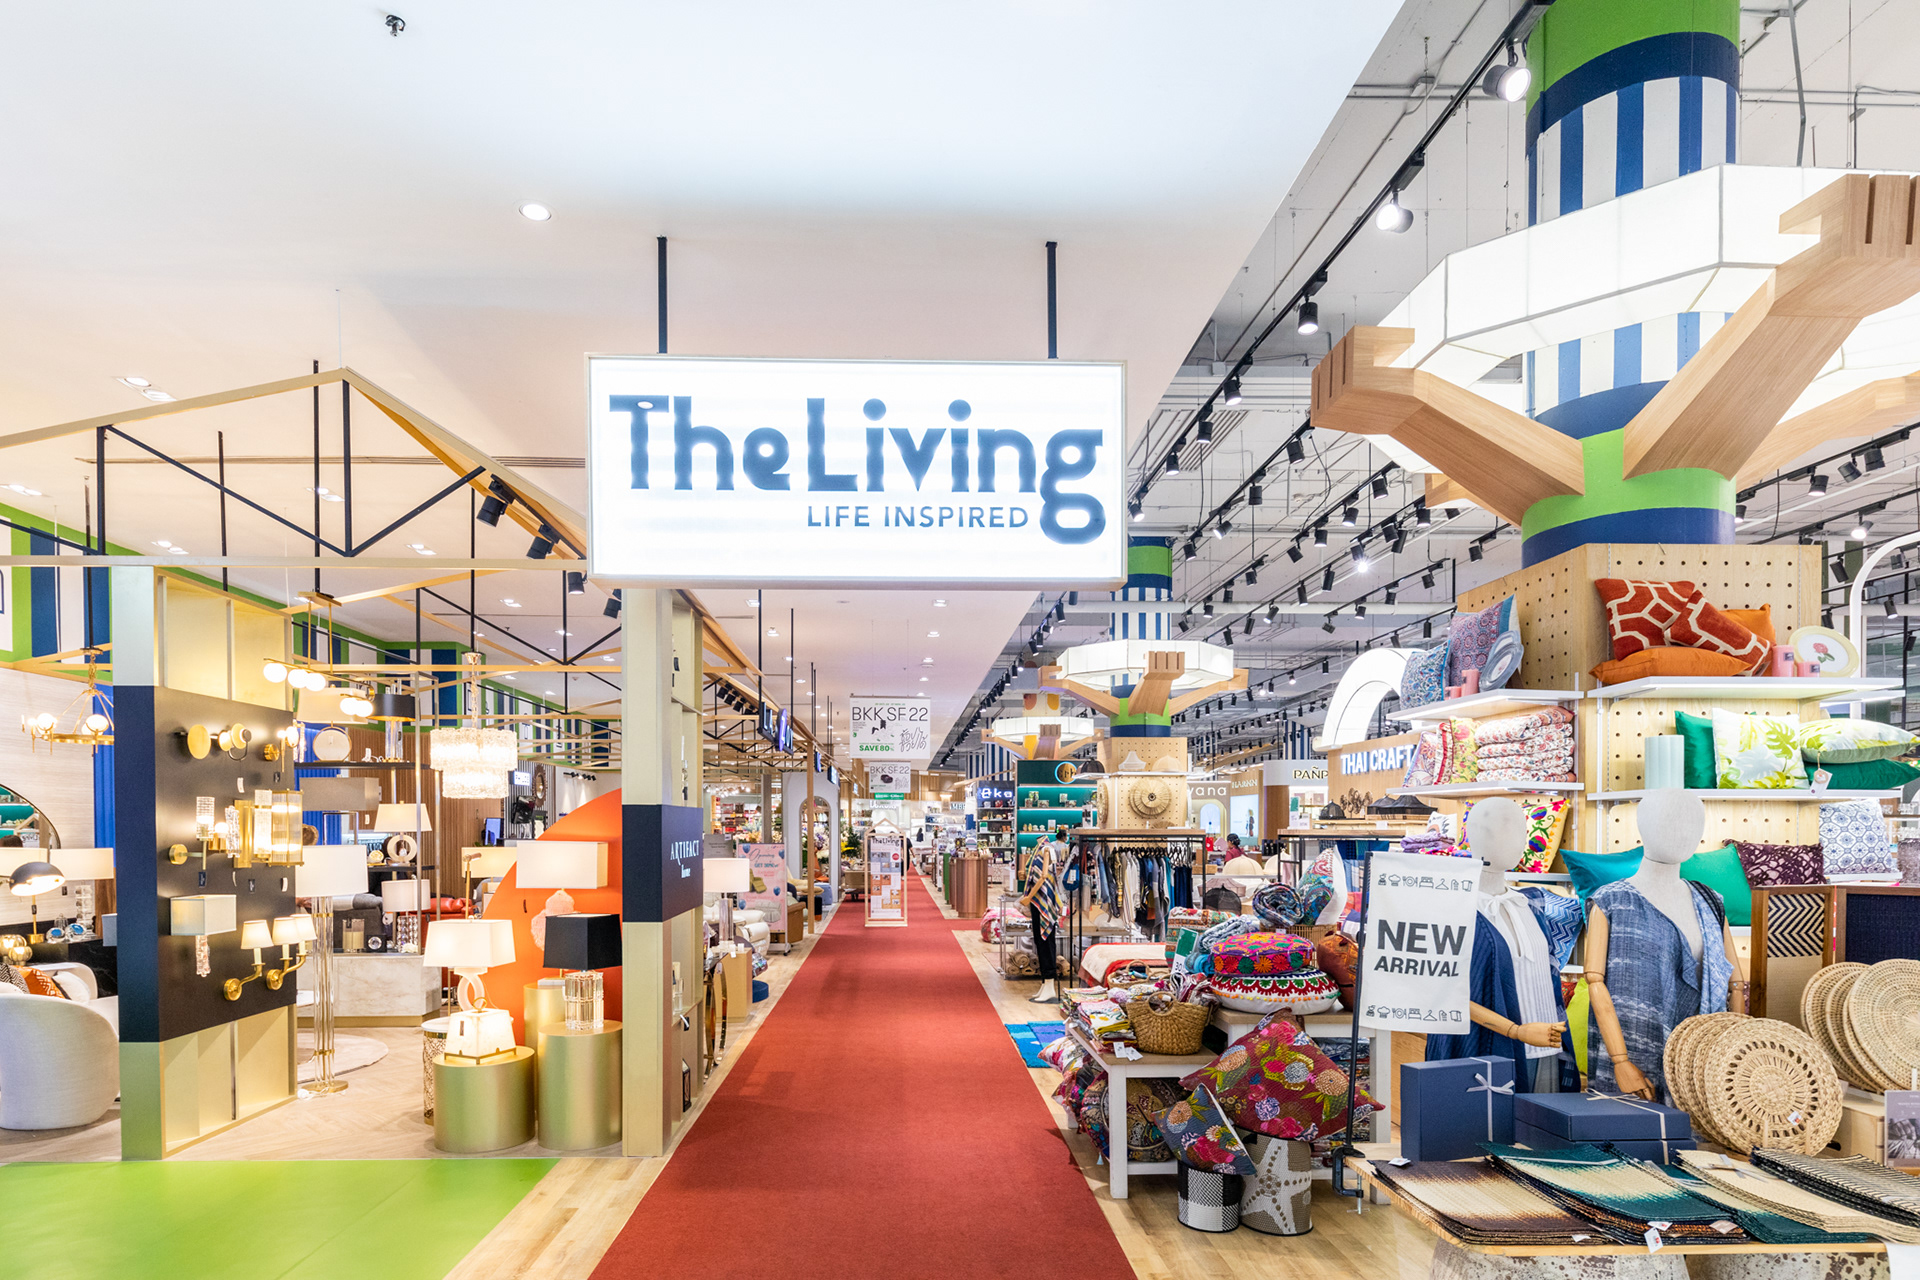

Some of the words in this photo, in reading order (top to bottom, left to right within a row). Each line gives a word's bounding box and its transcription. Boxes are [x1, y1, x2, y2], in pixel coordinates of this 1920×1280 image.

[807, 505, 870, 527] LIFE
[884, 505, 1029, 528] INSPIRED
[852, 707, 883, 721] BKK
[887, 707, 906, 721] SF
[909, 707, 928, 721] 22
[870, 766, 886, 774] BKK
[1340, 751, 1369, 775] THAI
[1370, 744, 1416, 771] CRAFT
[670, 839, 700, 866] ARTIFACT
[1377, 919, 1467, 956] NEW
[1373, 956, 1459, 977] ARRIVAL
